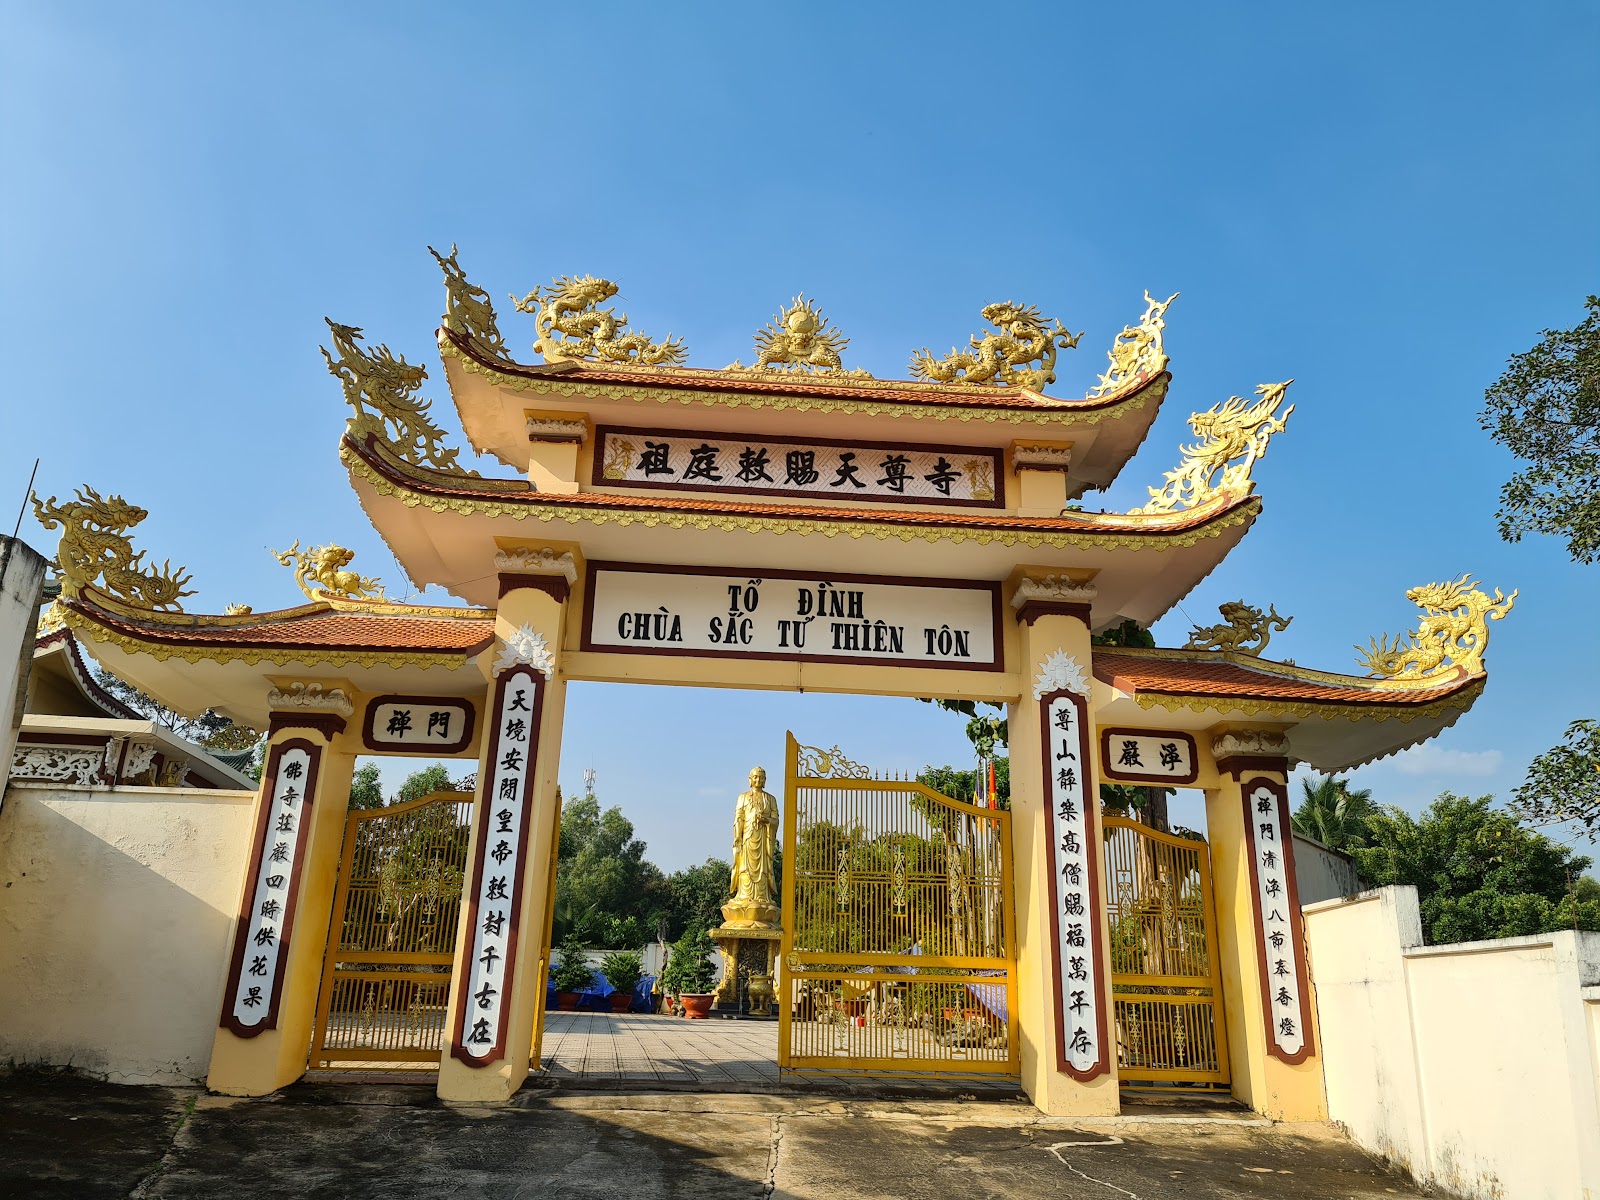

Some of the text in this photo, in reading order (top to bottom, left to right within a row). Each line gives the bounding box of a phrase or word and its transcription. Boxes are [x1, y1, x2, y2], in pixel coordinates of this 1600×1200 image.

[728, 578, 864, 619] TỔ ĐÌNH
[618, 606, 683, 642] CHÙA
[708, 612, 753, 645] SẮC
[831, 619, 904, 653] THIÊN
[924, 623, 971, 657] TÔN
